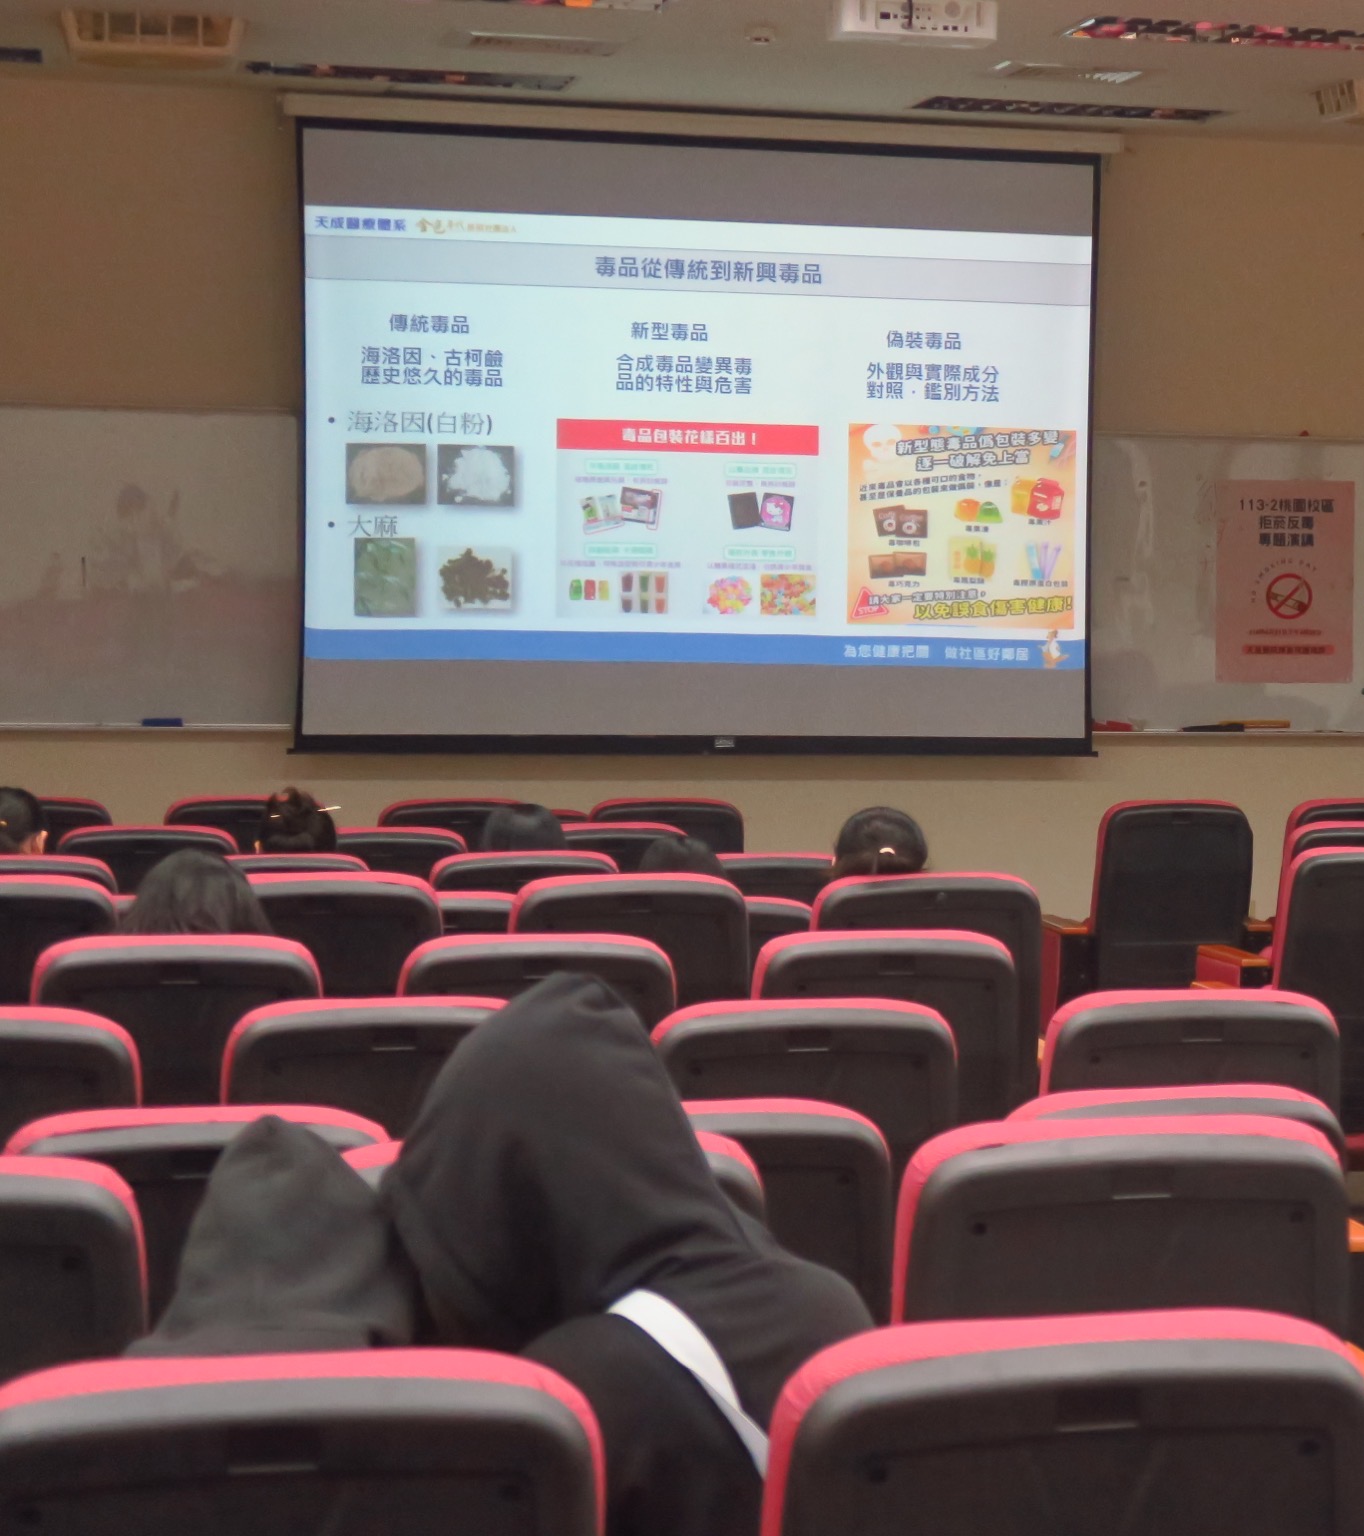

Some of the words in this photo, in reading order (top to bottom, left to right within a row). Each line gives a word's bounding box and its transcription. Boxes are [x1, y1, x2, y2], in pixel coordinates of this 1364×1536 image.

[315, 215, 406, 232] 天成醫療體系
[595, 257, 823, 285] 毒品從傳統到新興毒品
[389, 314, 470, 334] 傳統毒品
[631, 322, 709, 342] 新型毒品
[886, 331, 962, 350] 偽裝毒品
[360, 346, 504, 368] 海洛因、古柯鹼
[616, 354, 753, 376] 合成毒品變異毒
[360, 366, 504, 388] 歷史悠久的毒品
[866, 362, 1000, 384] 外觀與實際成分
[616, 373, 753, 396] 品的特性與危害
[347, 410, 493, 436] 海洛因(白粉)
[622, 428, 758, 446] 毒品包裝花樣百出！
[896, 430, 1060, 455] 新型態毒品偽包裝多變
[915, 449, 1031, 472] 逐一破解免上當
[1239, 498, 1335, 513] 113-2桃園校區
[347, 514, 399, 537] 大麻
[1258, 515, 1315, 530] 拒菸反毒
[1258, 532, 1315, 547] 專題演講
[843, 644, 930, 659] 為您健康把關
